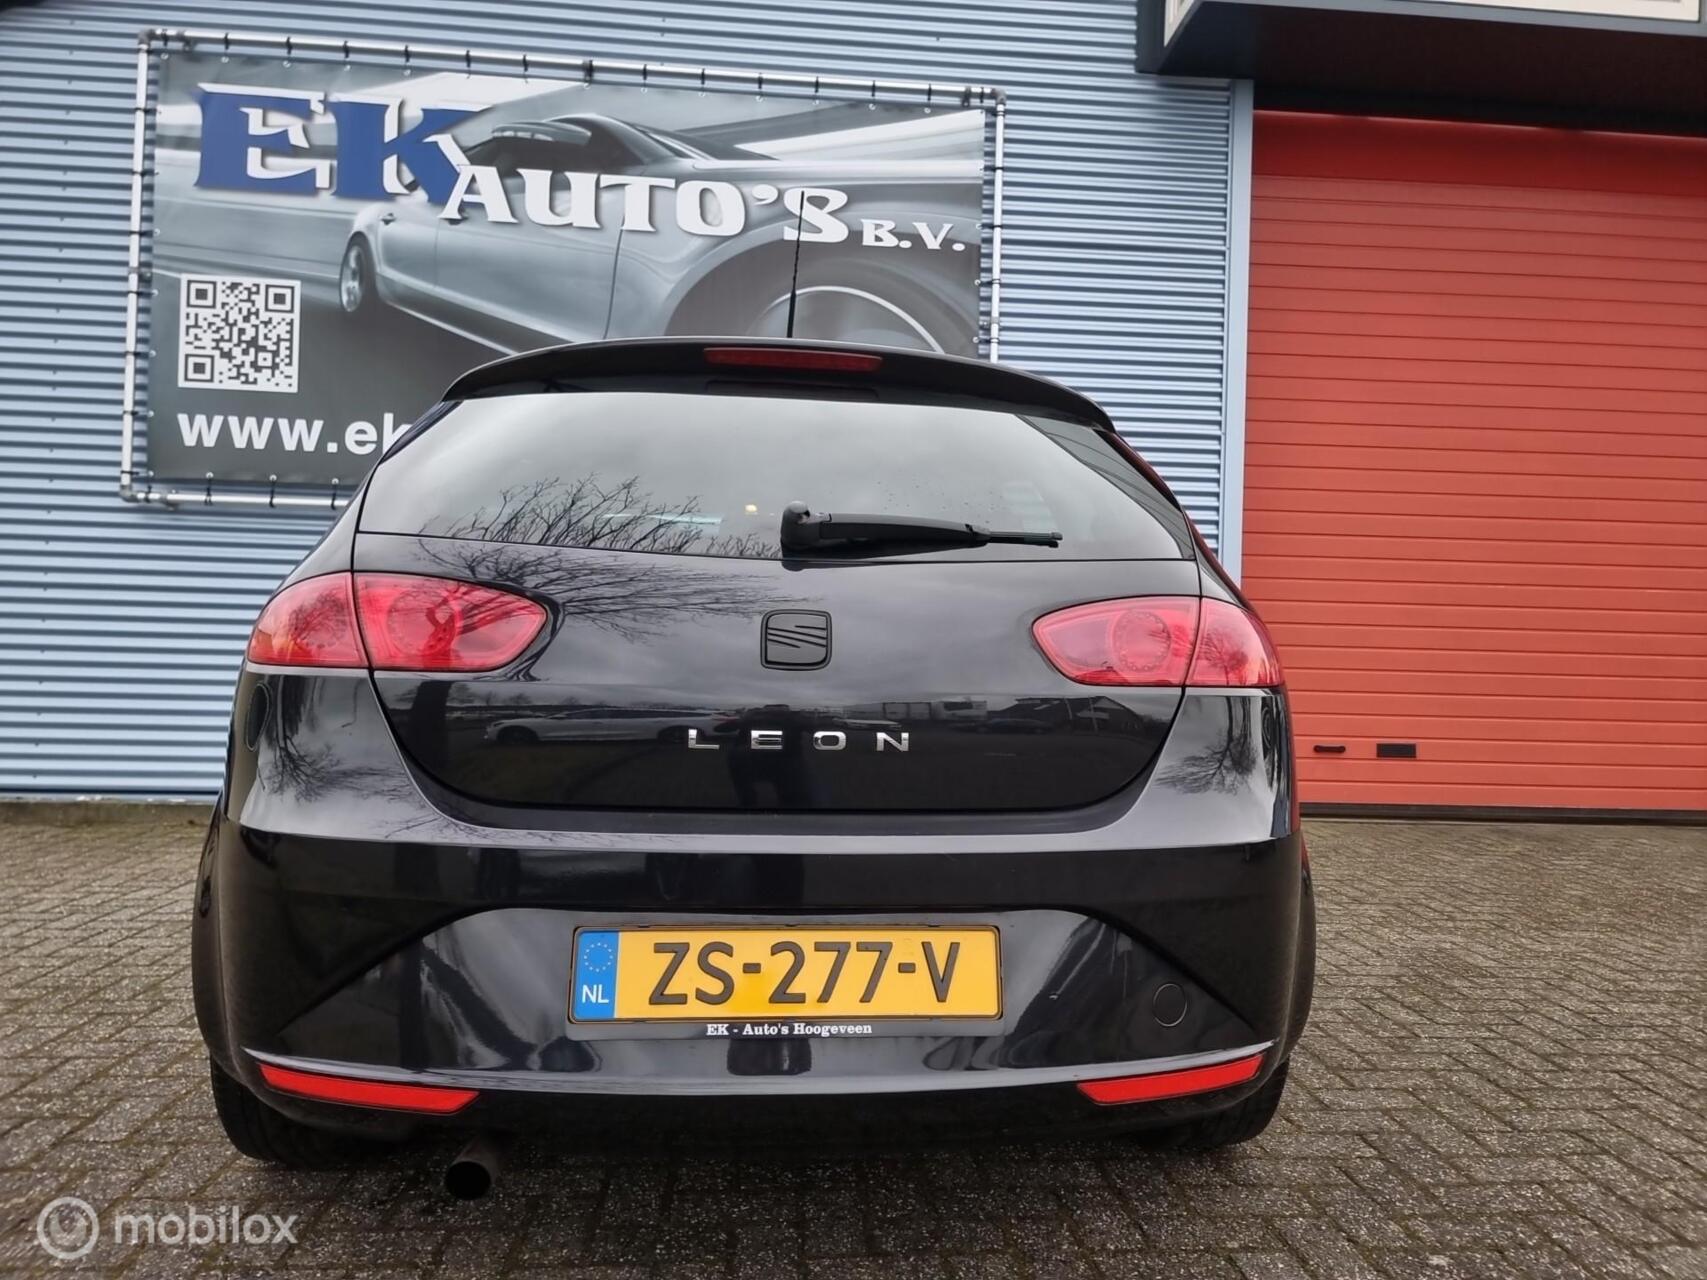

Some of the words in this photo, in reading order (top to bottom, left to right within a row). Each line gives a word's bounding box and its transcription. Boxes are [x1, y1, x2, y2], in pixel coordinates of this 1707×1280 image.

[194, 83, 494, 207] EK
[437, 165, 849, 244] AUTO'S
[861, 219, 966, 251] B.V.
[688, 729, 909, 752] LEON
[648, 941, 960, 1006] ZS-277-V
[581, 984, 609, 1004] NL
[706, 1024, 729, 1035] EK
[742, 1024, 789, 1035] Auto's
[793, 1023, 872, 1037] Hoogeveen
